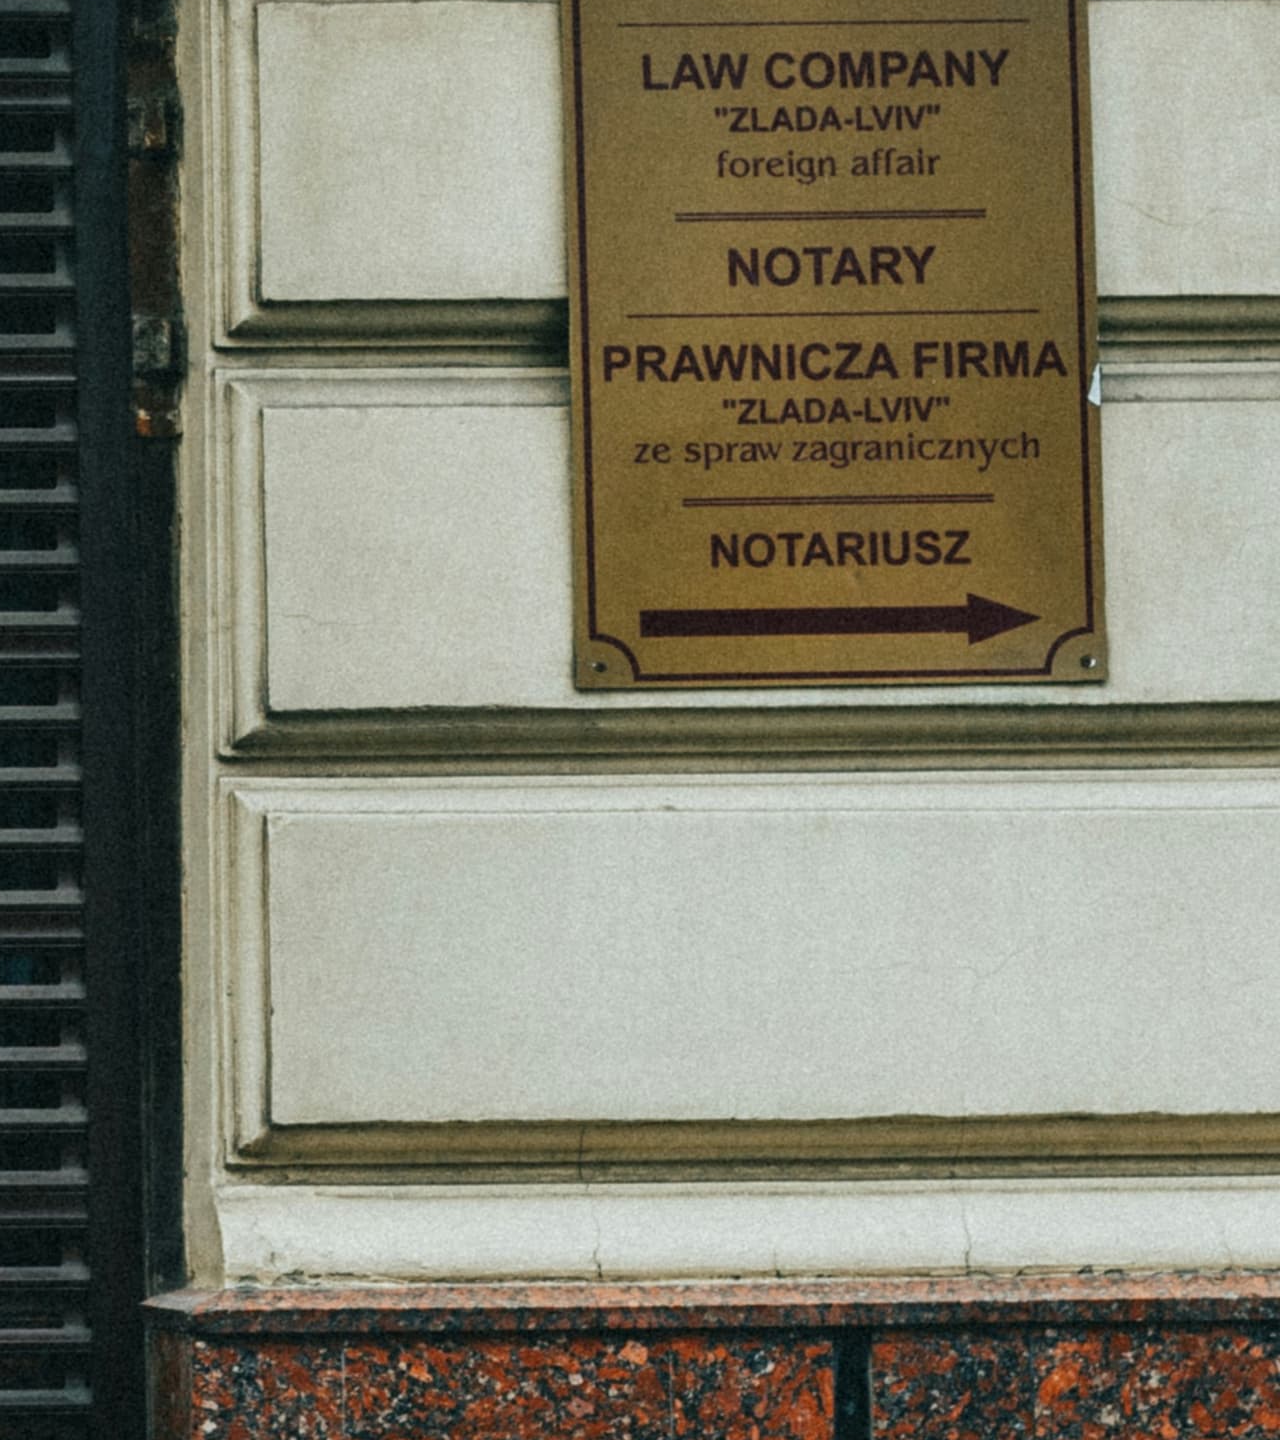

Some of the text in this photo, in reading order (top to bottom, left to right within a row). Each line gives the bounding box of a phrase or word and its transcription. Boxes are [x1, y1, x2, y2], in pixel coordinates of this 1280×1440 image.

[641, 48, 1010, 91] LAW COMPANY
[714, 103, 941, 134] "ZLADA-LVIV"
[716, 148, 941, 185] foreign affair
[727, 245, 936, 287] NOTARY
[602, 340, 1068, 383] PRAWNICZA FIRMA
[722, 395, 951, 426] "ZLADA-LVIV"
[633, 430, 1041, 473] ze spraw zagranicznych
[710, 530, 972, 569] NOTARIUSZ
